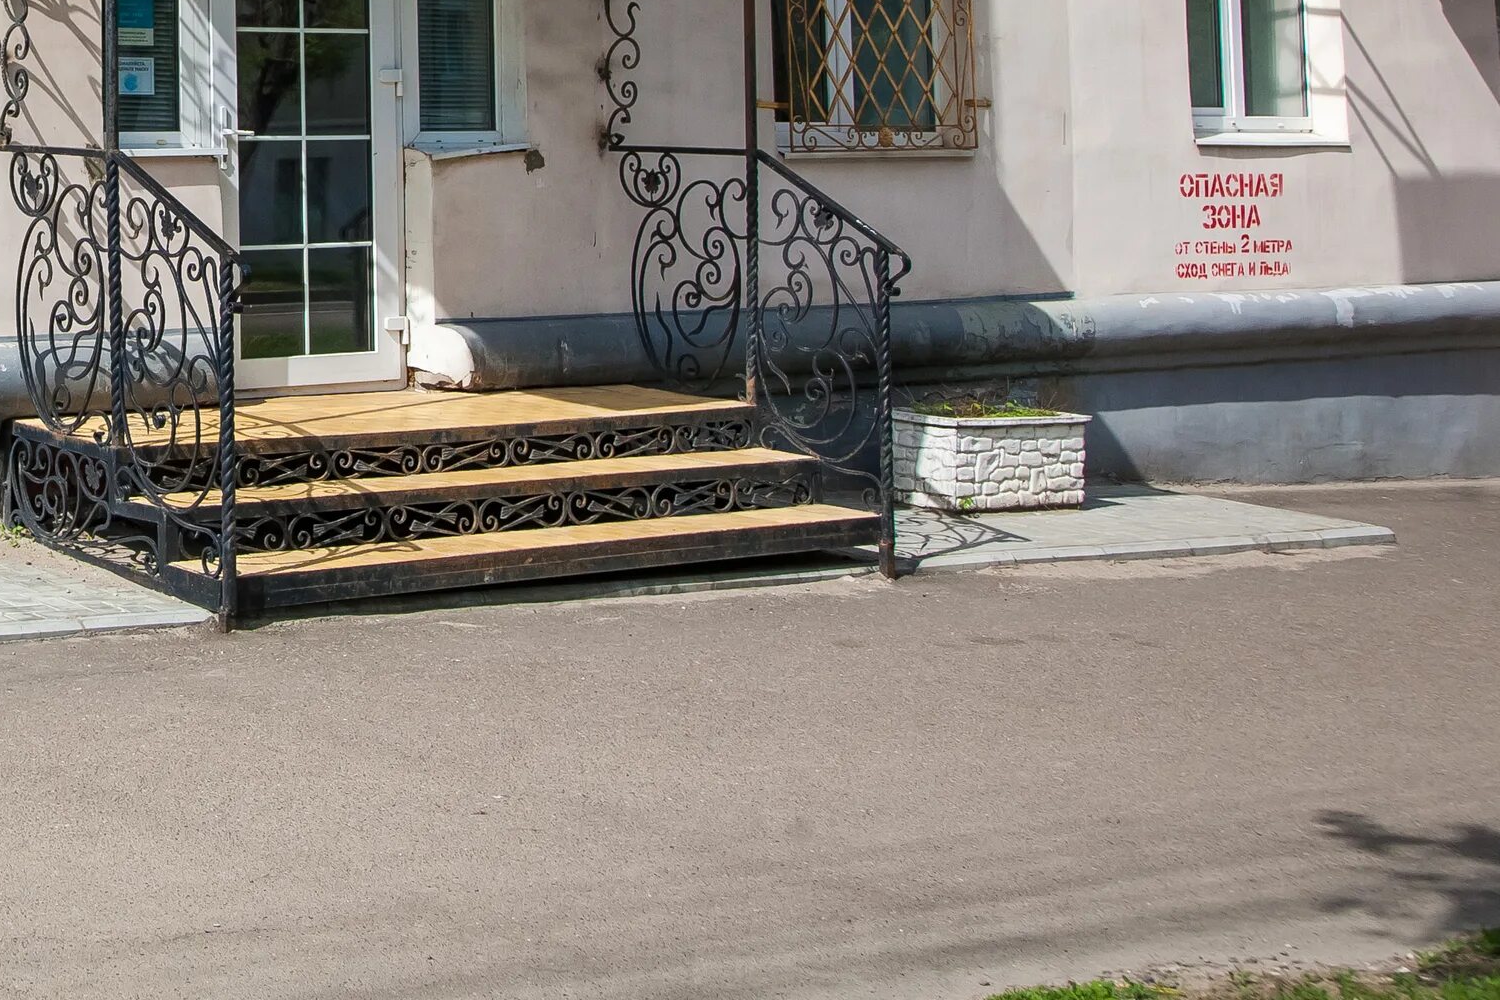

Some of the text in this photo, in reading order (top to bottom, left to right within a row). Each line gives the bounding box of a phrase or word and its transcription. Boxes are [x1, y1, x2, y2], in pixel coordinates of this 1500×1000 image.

[1180, 173, 1284, 198] ОПАСНАЯ
[1202, 204, 1260, 229] ЗОНА
[1175, 241, 1190, 255] ОТ
[1241, 233, 1250, 253] 2
[1253, 239, 1293, 254] МЕТРА
[1211, 262, 1245, 277] СНЕГА
[1248, 261, 1256, 276] И
